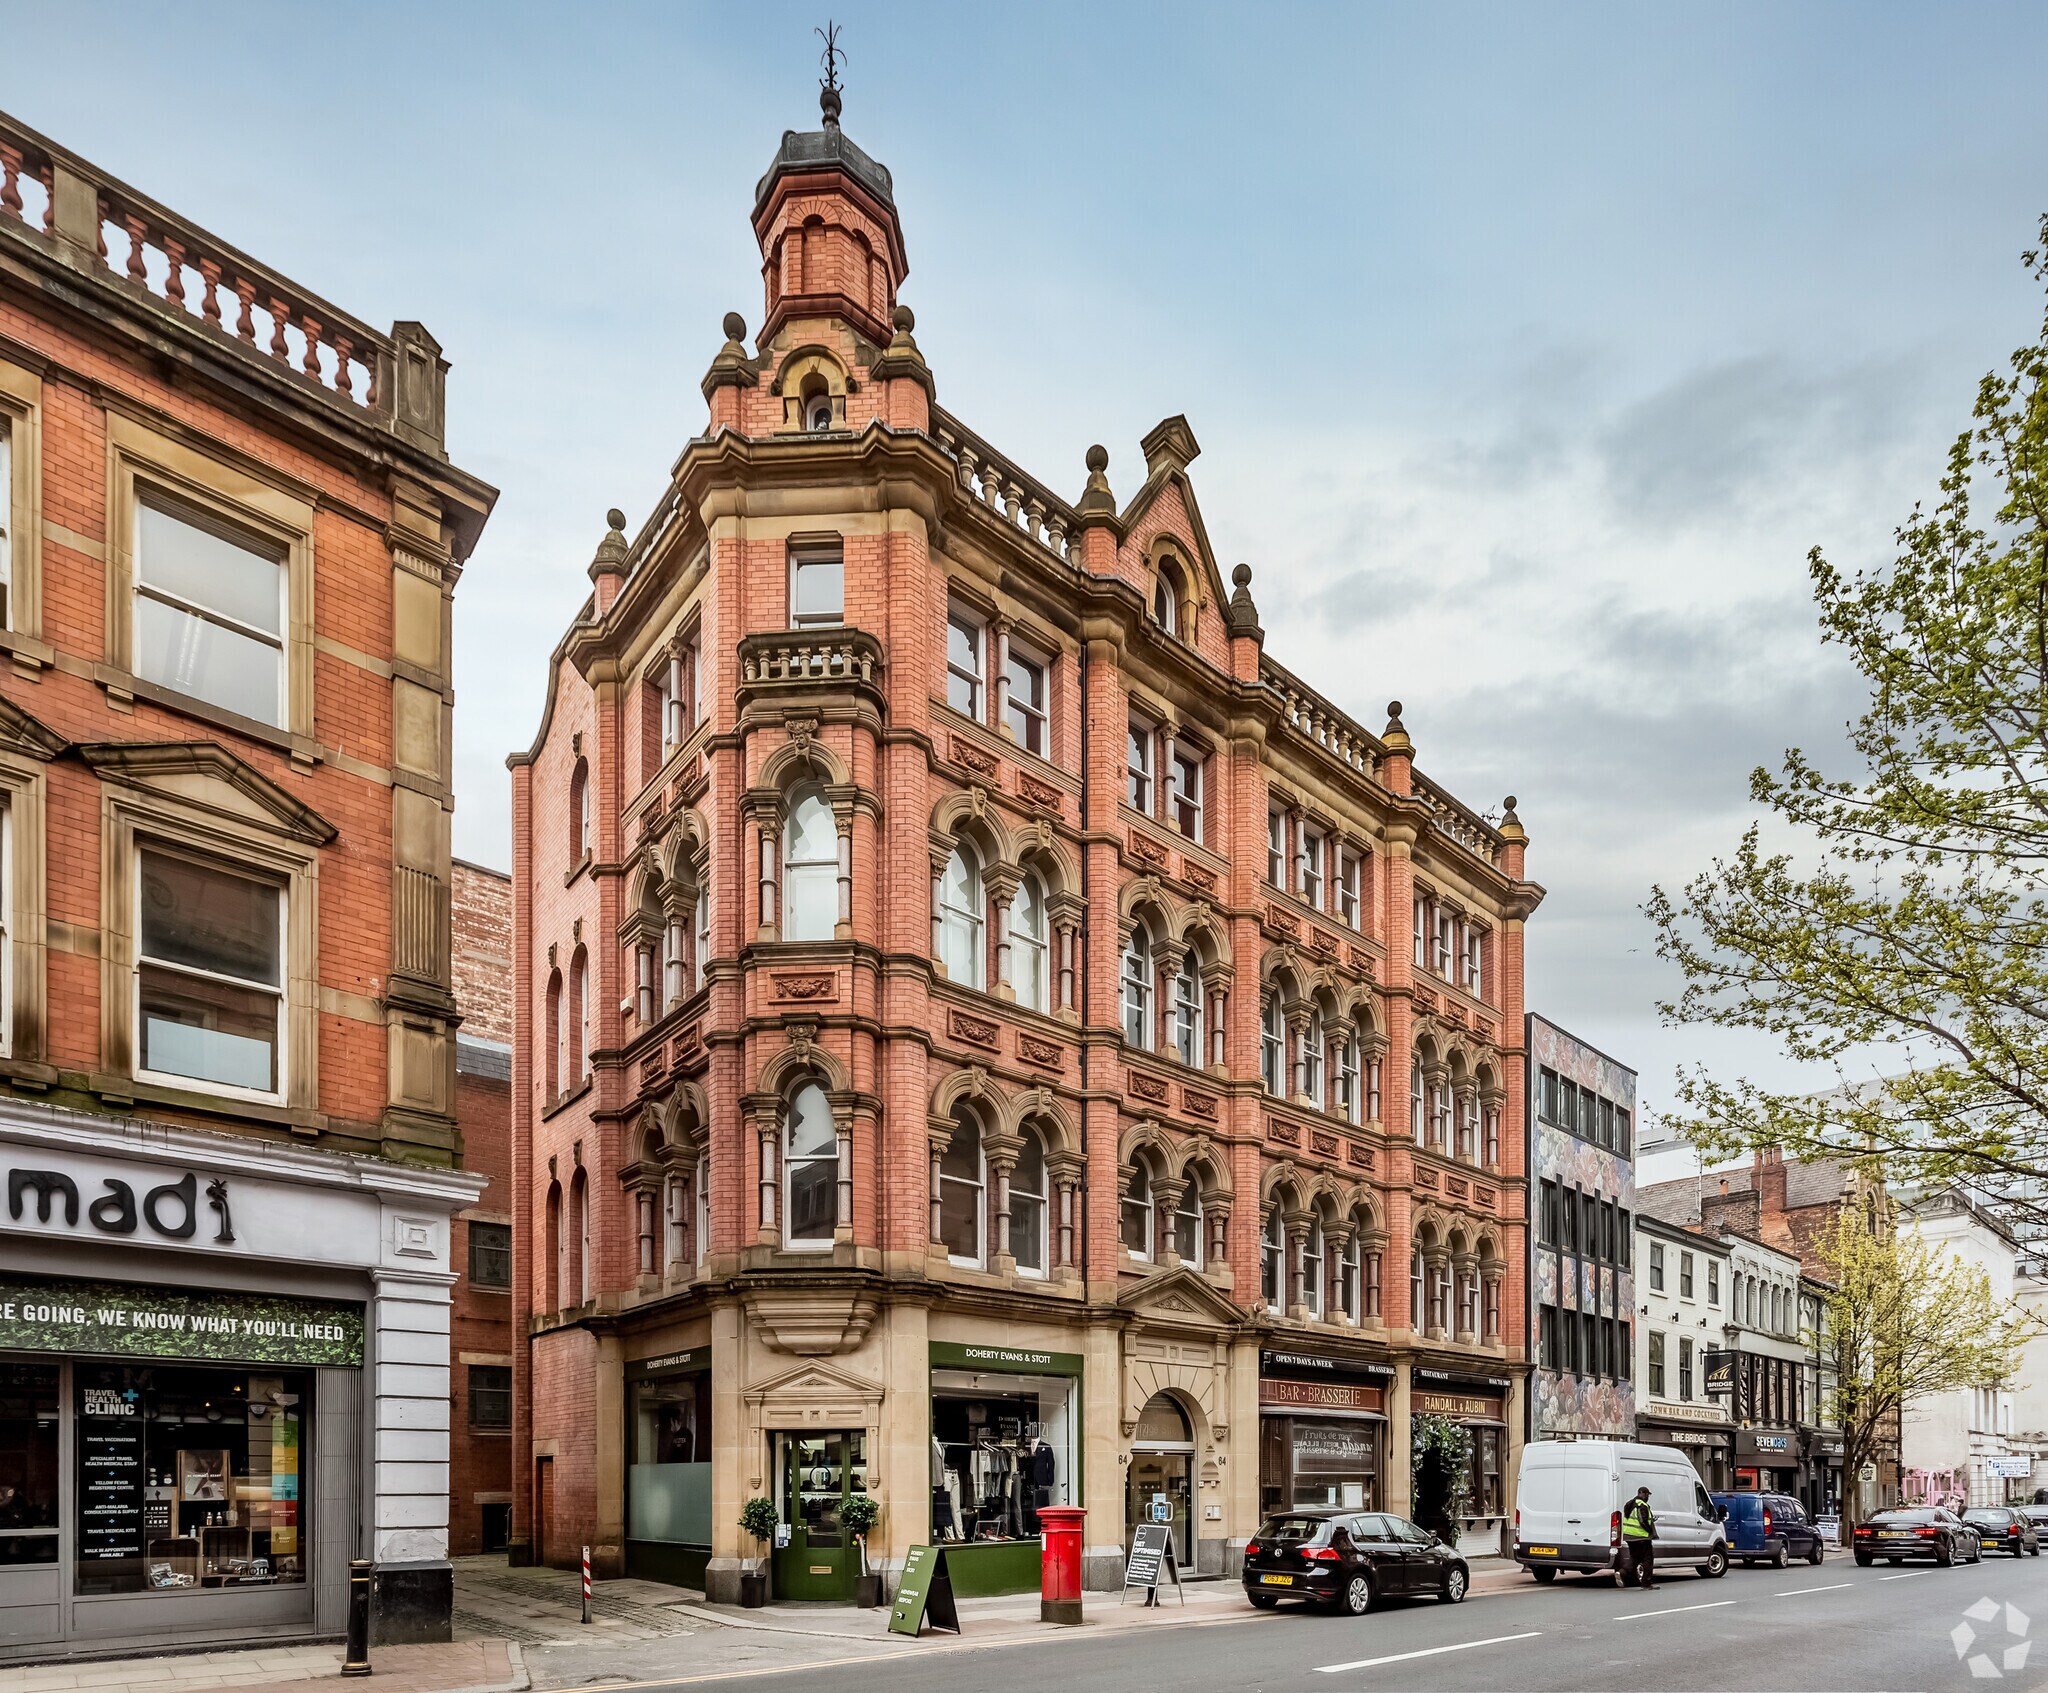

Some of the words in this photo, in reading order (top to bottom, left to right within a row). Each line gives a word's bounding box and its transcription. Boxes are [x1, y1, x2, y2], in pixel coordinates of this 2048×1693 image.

[0, 1303, 16, 1320] E
[23, 1305, 91, 1327] GOING,
[97, 1309, 127, 1327] WE
[132, 1311, 185, 1330] KNOW
[191, 1316, 238, 1334] WHAT
[244, 1319, 300, 1338] YOU'LL
[303, 1323, 344, 1341] NEED
[966, 1348, 999, 1360] DOHERTY
[1000, 1351, 1024, 1362] EVANS
[1024, 1354, 1030, 1363] &
[1031, 1354, 1051, 1364] STOTT
[1275, 1355, 1292, 1364] OPEN
[1292, 1356, 1297, 1364] 7
[1296, 1357, 1312, 1366] DAYS
[1311, 1359, 1317, 1367] A
[1316, 1359, 1334, 1368] WEEK
[646, 1359, 663, 1370] DOHERTY
[1368, 1365, 1396, 1375] BRASSERIE
[1420, 1369, 1449, 1380] RESTAURANT
[84, 1389, 117, 1397] TRAVEL
[1280, 1384, 1300, 1400] BAR
[1308, 1386, 1361, 1405] BRASSERIE
[85, 1396, 121, 1404] HEALTH
[1424, 1396, 1457, 1412] RANDALL
[1459, 1403, 1464, 1412] &
[1465, 1400, 1486, 1414] AUBIN
[84, 1403, 135, 1415] CLINIC
[1650, 1405, 1667, 1414] TOWN
[1668, 1406, 1680, 1416] BAR
[1681, 1408, 1693, 1418] AND
[1693, 1409, 1720, 1420] COCKTAILS
[1304, 1429, 1327, 1440] Fruits
[1671, 1432, 1685, 1442] THE
[1684, 1433, 1707, 1444] BRIDGE
[1118, 1454, 1128, 1465] 64
[1218, 1456, 1226, 1466] 64
